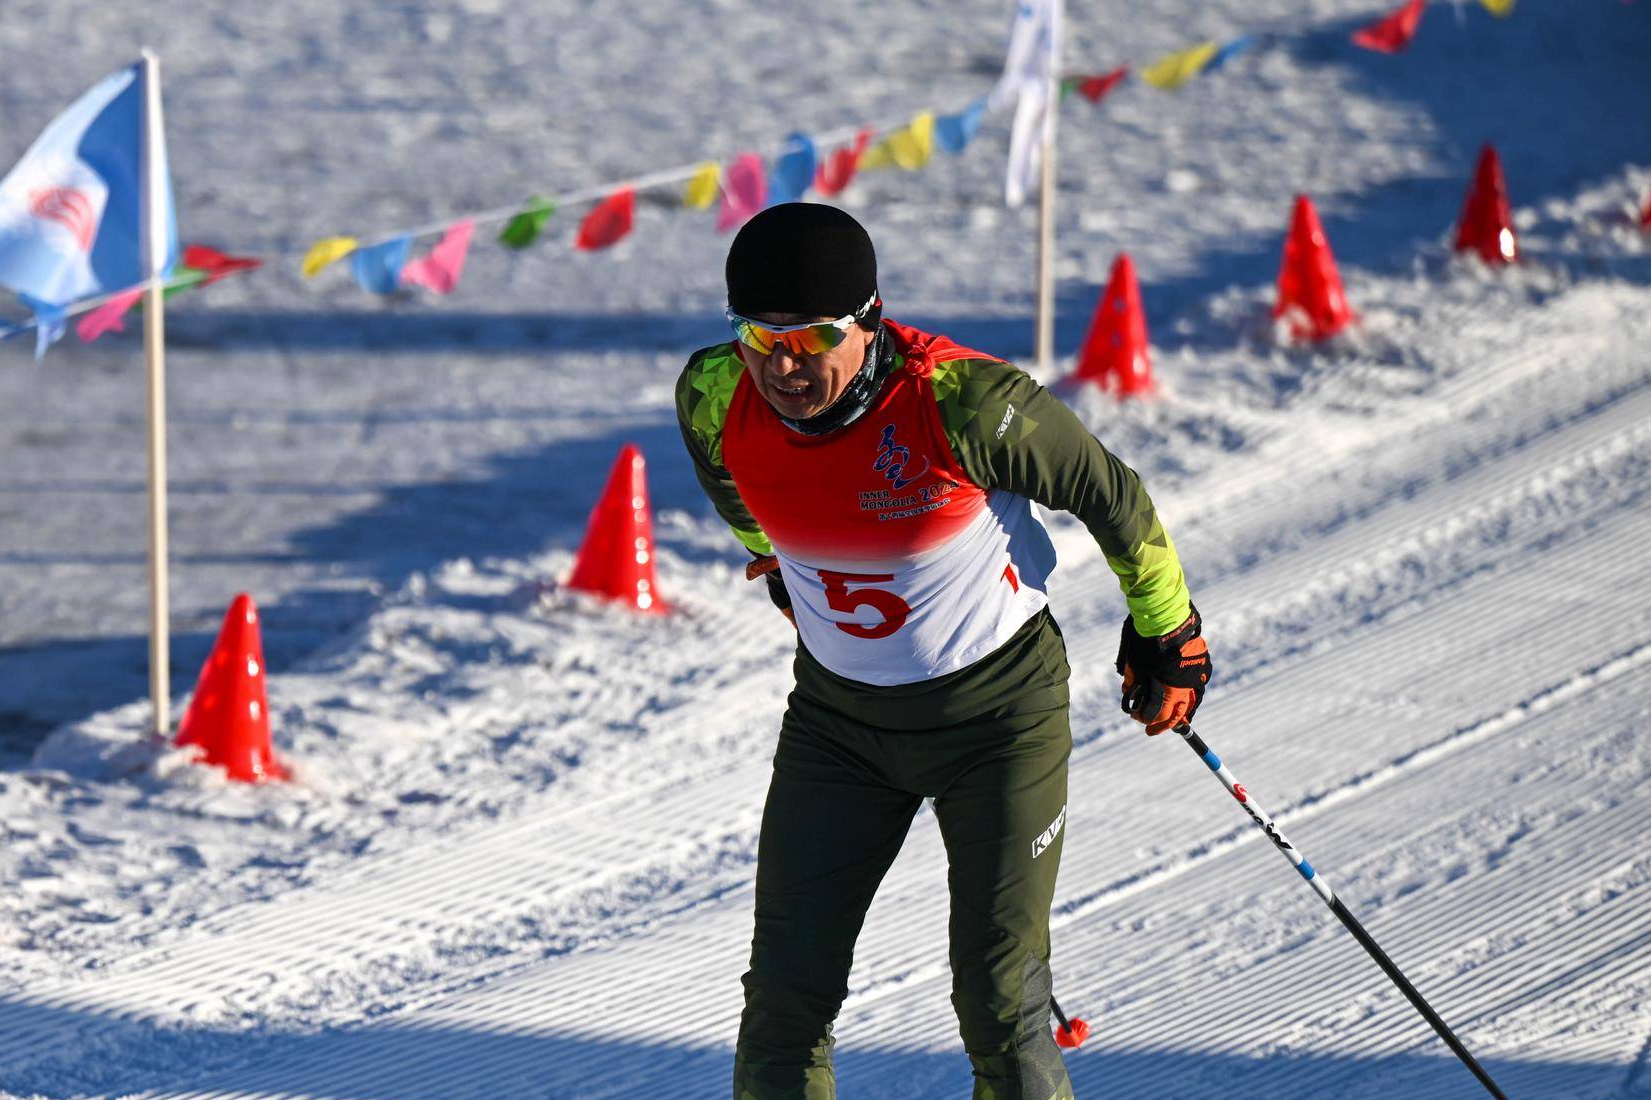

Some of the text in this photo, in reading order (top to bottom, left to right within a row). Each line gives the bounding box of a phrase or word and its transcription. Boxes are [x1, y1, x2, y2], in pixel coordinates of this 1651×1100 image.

[860, 490, 890, 500] INNER
[860, 496, 916, 511] MONGOLIA
[817, 569, 912, 639] 5
